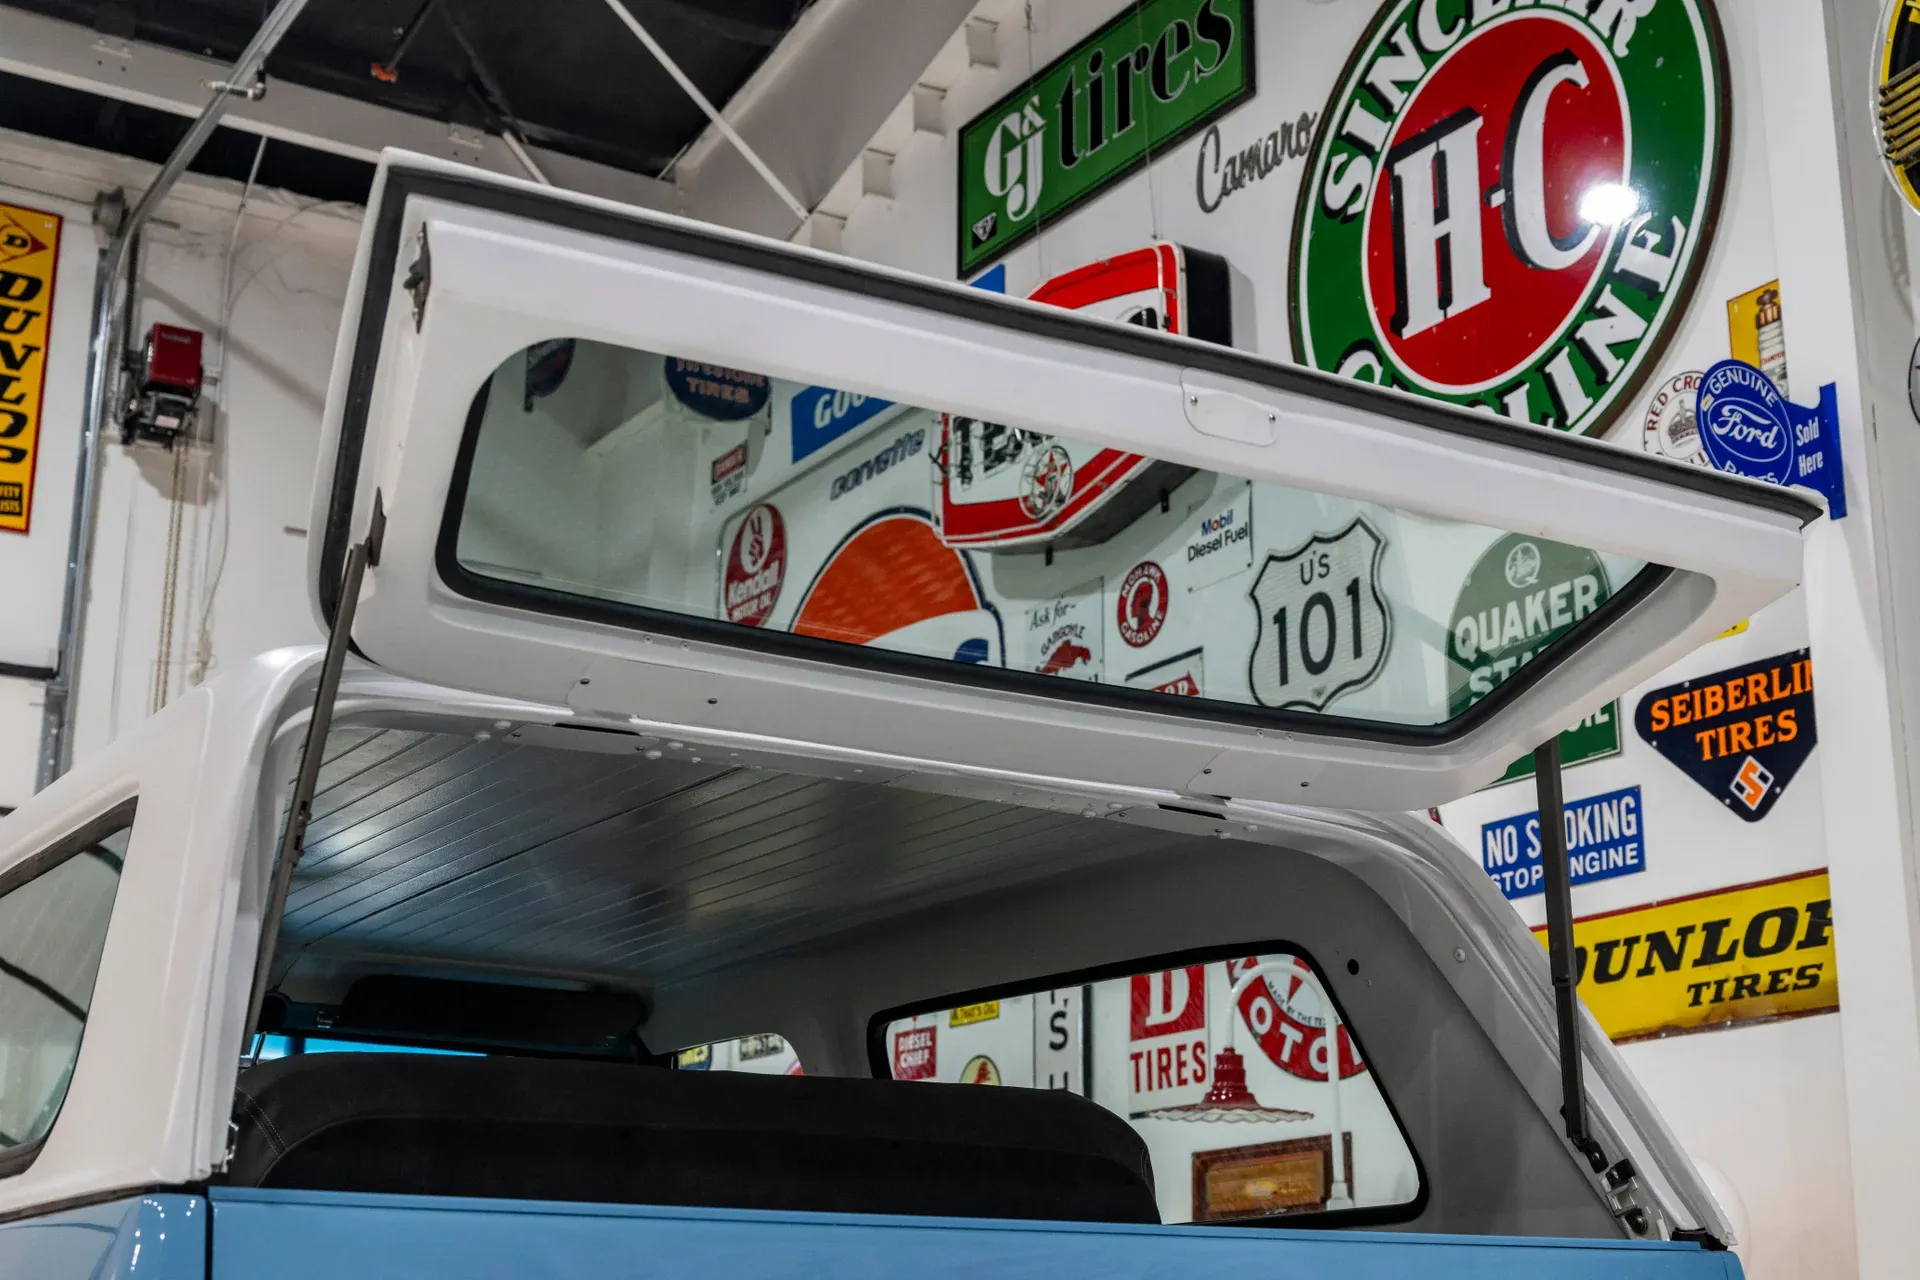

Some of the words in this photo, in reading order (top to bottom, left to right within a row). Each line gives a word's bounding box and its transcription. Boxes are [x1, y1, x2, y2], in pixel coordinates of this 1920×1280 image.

[1055, 0, 1234, 170] tires
[1196, 112, 1318, 214] Camaro
[1709, 366, 1778, 408] GENUINE
[1646, 392, 1669, 431] RED
[1713, 404, 1779, 449] Ford
[1796, 416, 1820, 447] Sold
[1798, 450, 1824, 478] Here
[1187, 536, 1224, 562] Diesel
[1224, 521, 1250, 552] Fuel
[1201, 509, 1234, 537] Mobil
[728, 560, 780, 609] Kendall
[1121, 565, 1162, 597] MOHAWK
[1120, 611, 1164, 644] GASOLINE
[1273, 577, 1363, 686] 101
[1454, 574, 1599, 662] QUAKER
[1696, 708, 1798, 762] TIRES
[1486, 824, 1518, 868] NO
[1525, 795, 1638, 859] SOKING
[1569, 842, 1640, 878] NGINE
[1686, 962, 1824, 1008] TIRES
[898, 1031, 932, 1051] DIESEL
[900, 1048, 931, 1068] CHIEF
[1129, 1041, 1207, 1094] TIRES
